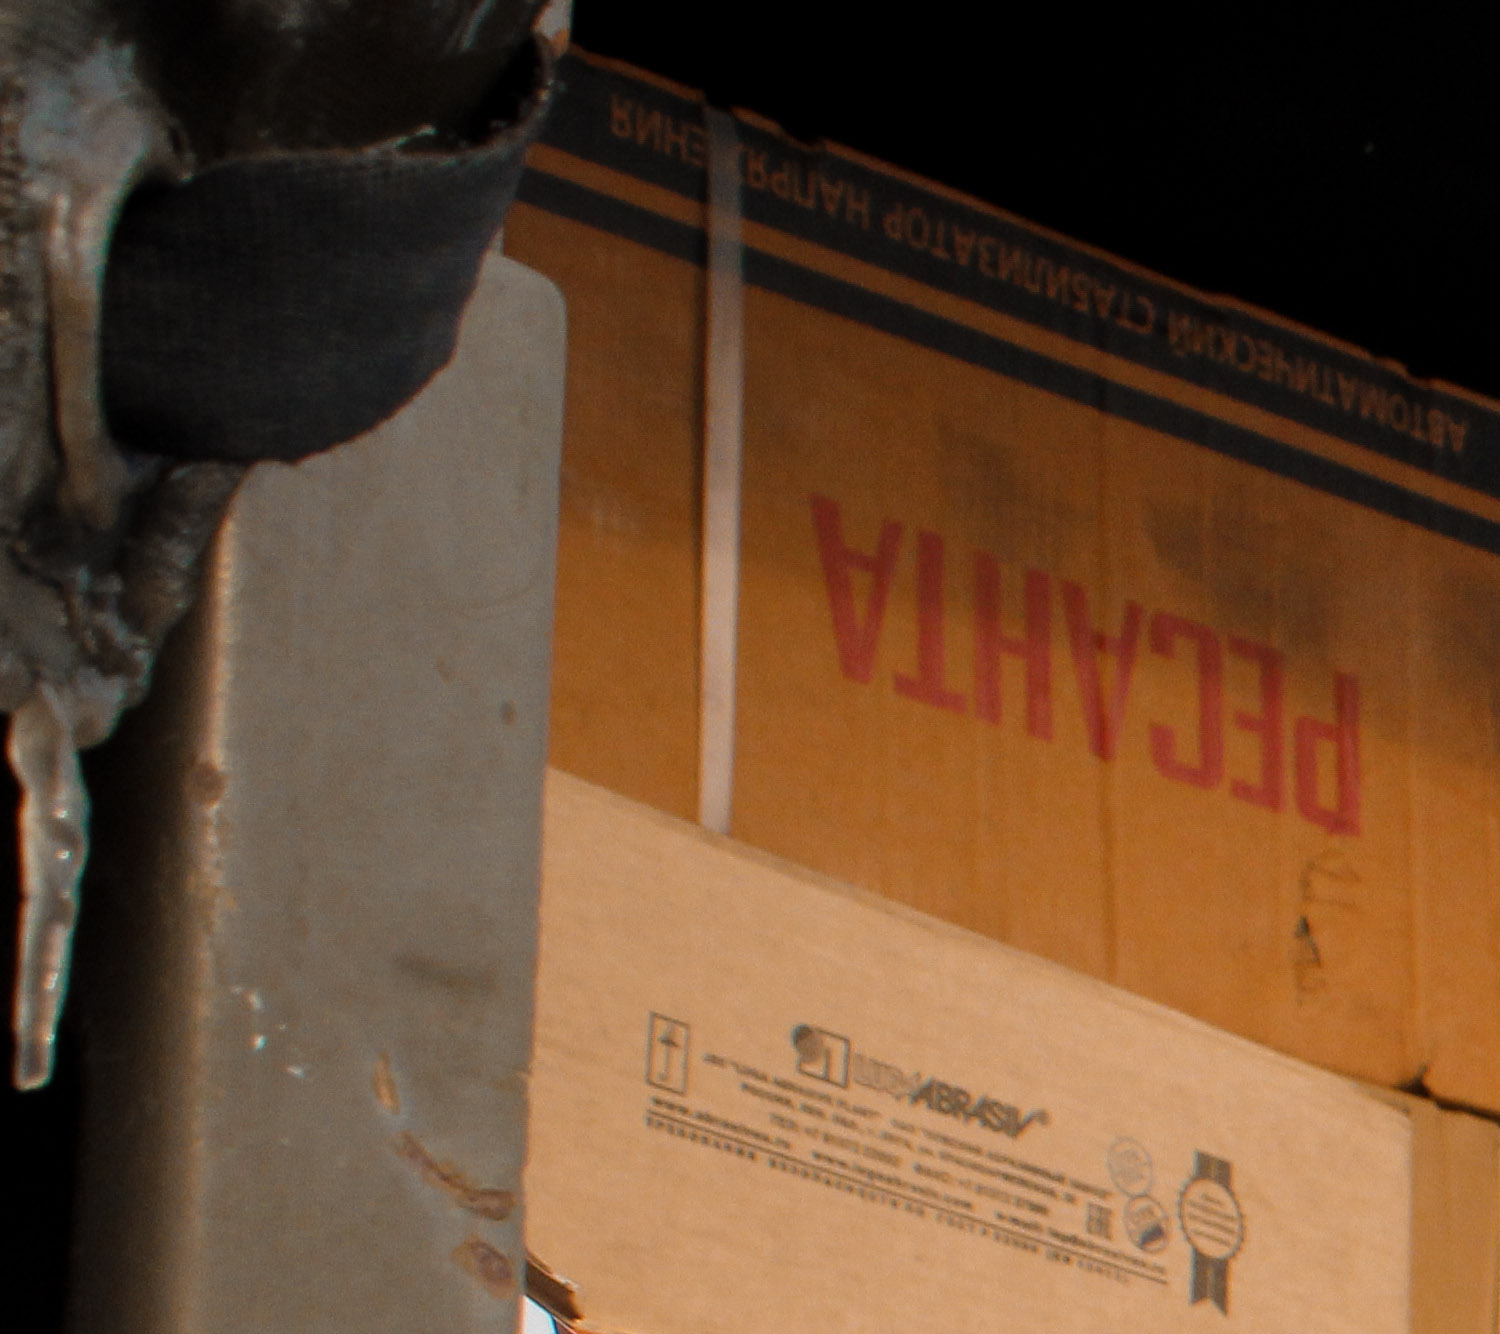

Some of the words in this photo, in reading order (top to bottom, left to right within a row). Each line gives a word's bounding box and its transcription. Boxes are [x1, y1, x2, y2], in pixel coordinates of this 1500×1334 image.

[609, 93, 873, 231] НАПРЯЕНИЯ
[882, 205, 1156, 335] СТАБИЛИЗАТОР
[1167, 307, 1469, 453] АВТОМАТИЧЕСКИЙ
[810, 493, 1362, 837] РЕСАНТА
